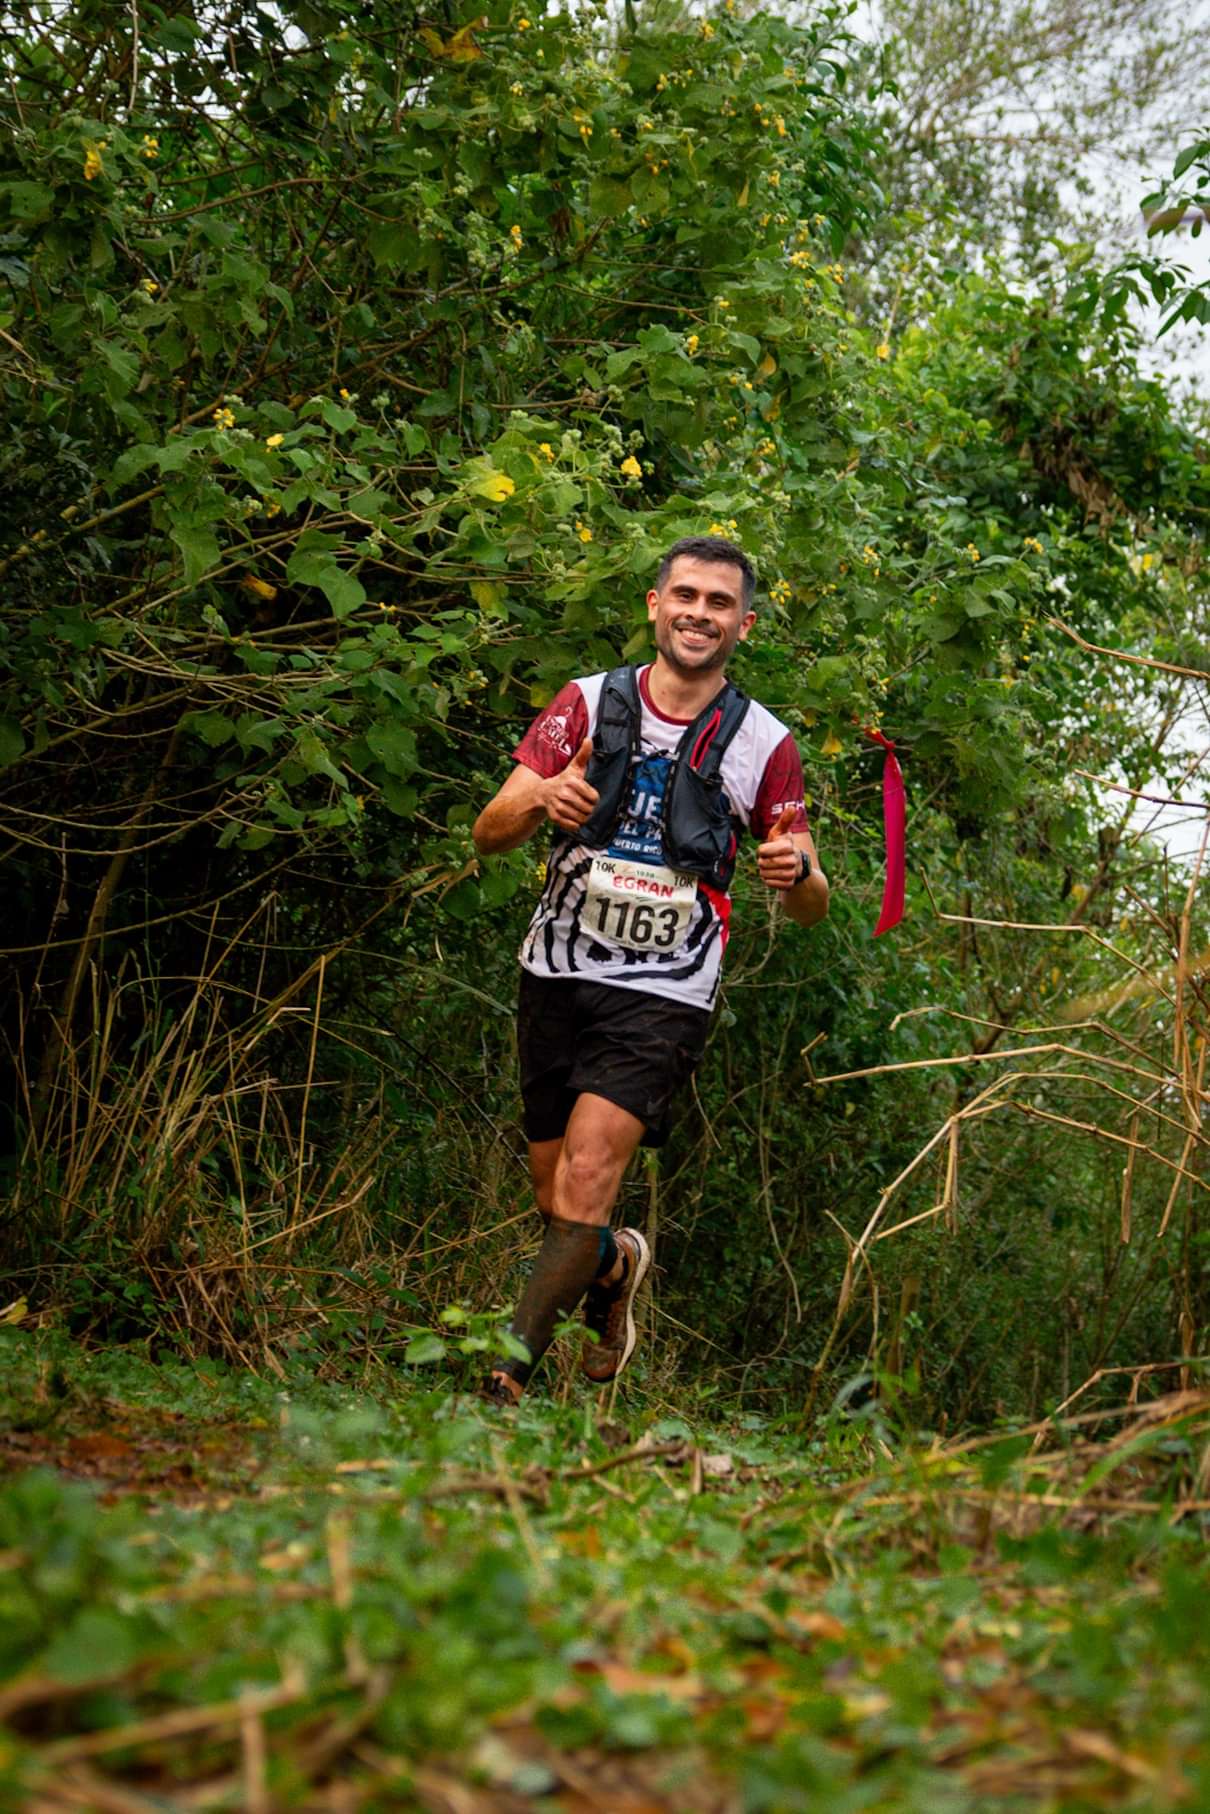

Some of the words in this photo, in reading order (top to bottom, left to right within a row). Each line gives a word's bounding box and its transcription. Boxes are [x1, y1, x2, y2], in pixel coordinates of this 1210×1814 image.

[595, 860, 616, 875] 10K
[674, 875, 694, 889] 10K
[612, 874, 674, 898] EGRAN
[596, 896, 680, 947] 1163
